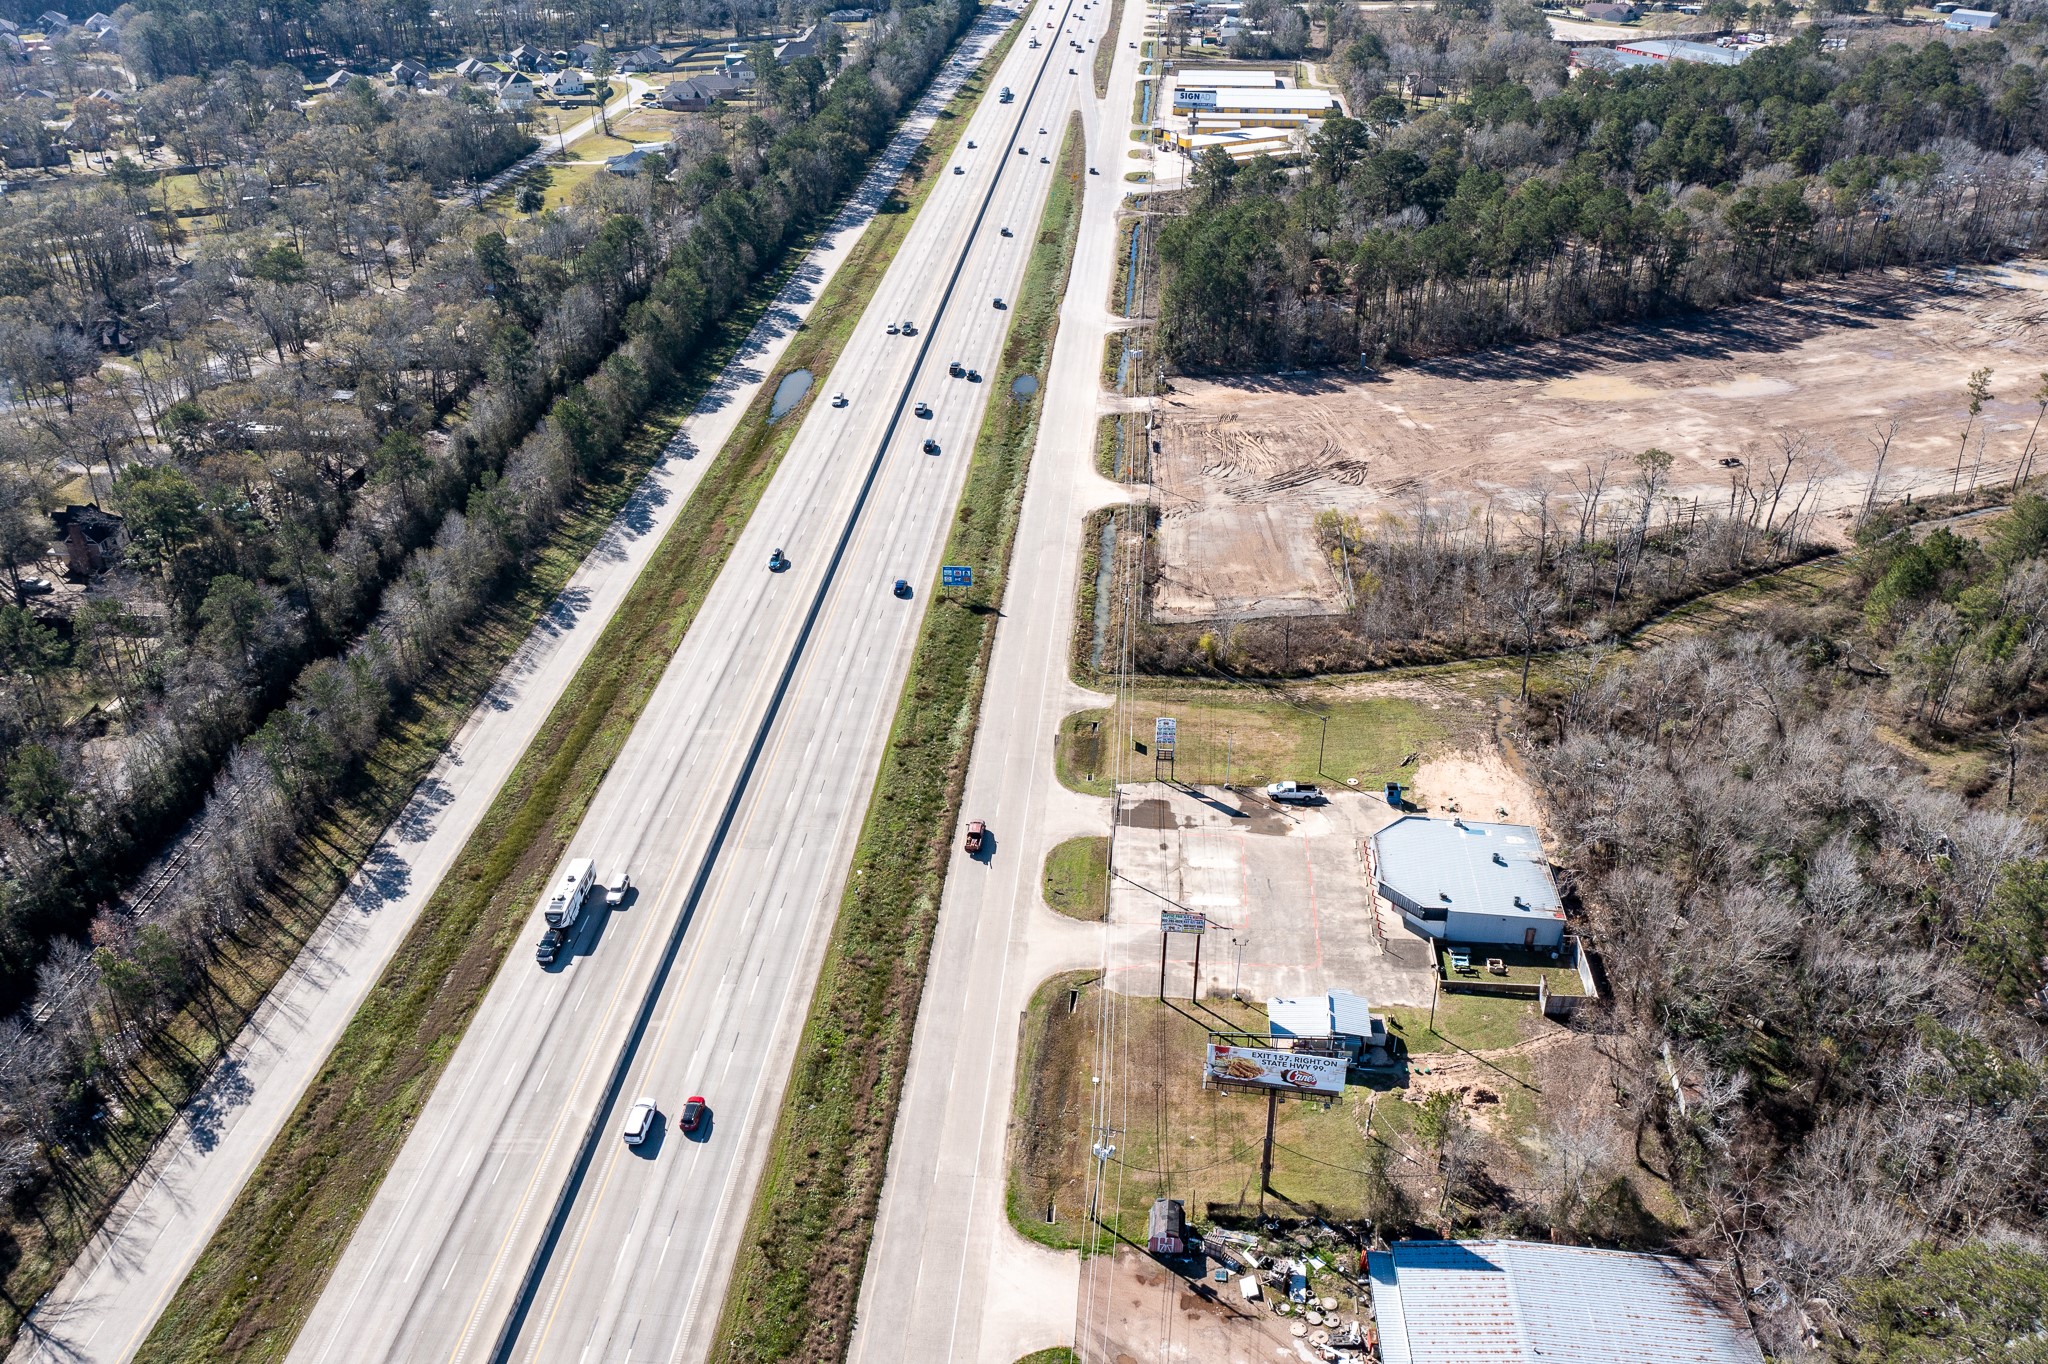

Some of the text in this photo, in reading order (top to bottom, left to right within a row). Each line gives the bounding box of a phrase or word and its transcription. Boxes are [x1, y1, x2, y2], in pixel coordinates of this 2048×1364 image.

[1252, 1052, 1271, 1060] EXIT
[1274, 1054, 1292, 1062] 157.
[1294, 1056, 1321, 1065] RIGHT
[1261, 1059, 1287, 1068] STATE
[1289, 1062, 1311, 1071] HWY
